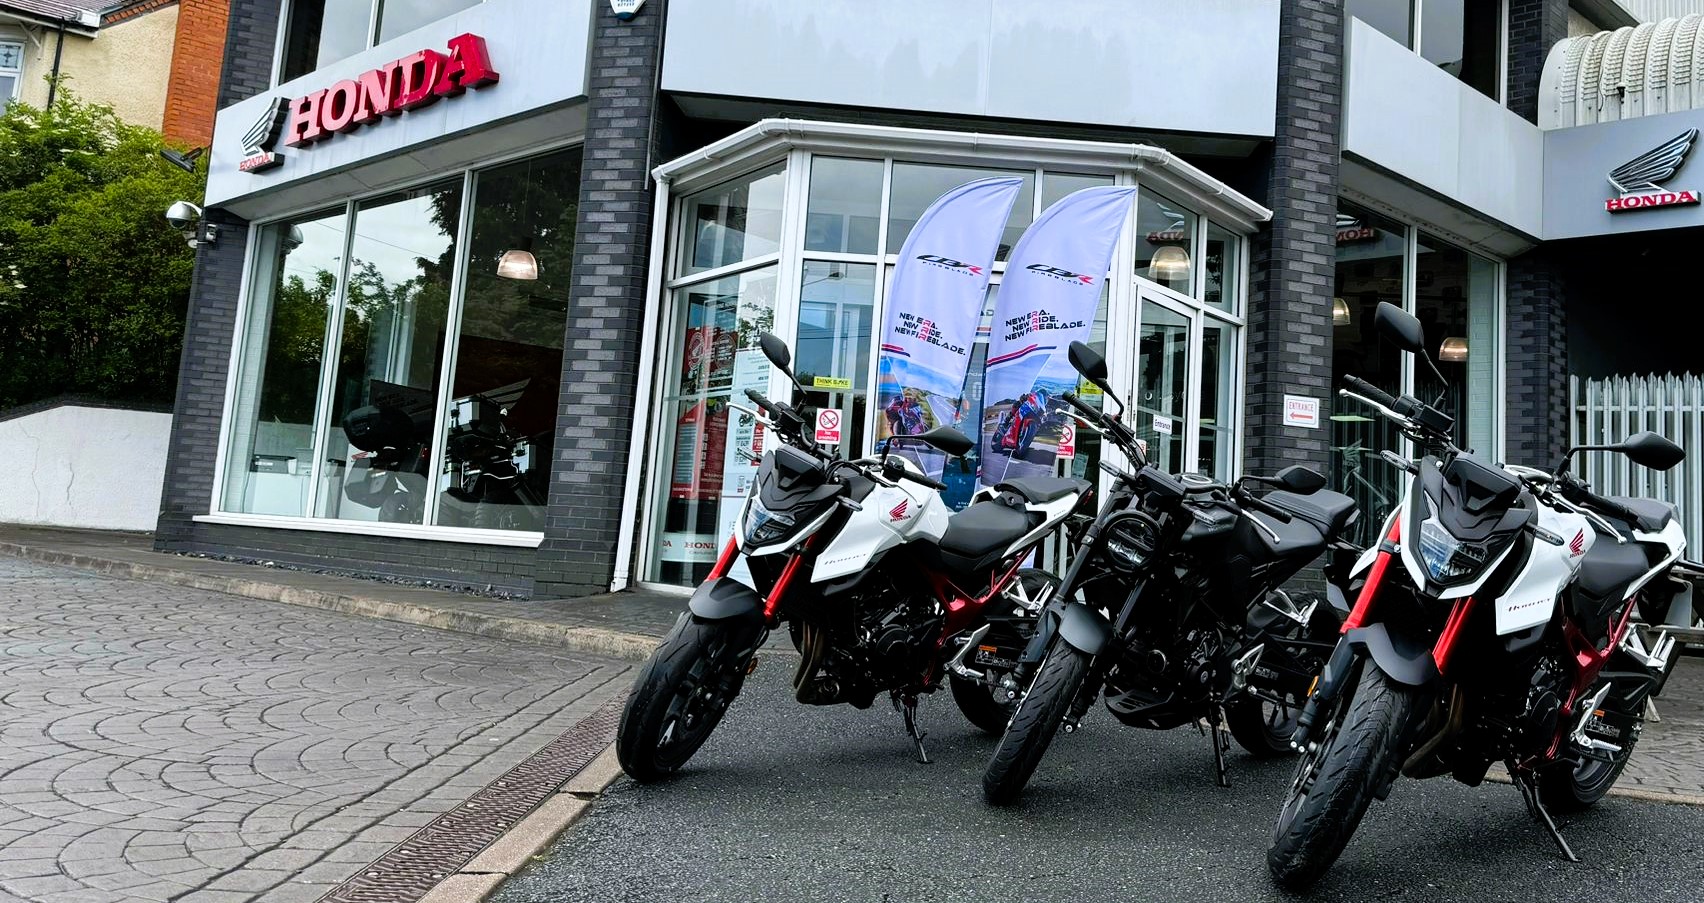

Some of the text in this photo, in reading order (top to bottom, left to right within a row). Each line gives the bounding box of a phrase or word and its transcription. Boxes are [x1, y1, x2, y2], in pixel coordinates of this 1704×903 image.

[284, 32, 500, 147] HONDA
[239, 152, 272, 171] HONDA
[1606, 191, 1696, 211] HONDA
[916, 254, 984, 276] CBR
[1026, 264, 1095, 285] CBR
[916, 317, 938, 330] ERA.
[1005, 309, 1050, 327] NEW ERA.
[1012, 315, 1059, 332] NEW RIDE.
[920, 326, 943, 339] RIDE.
[1005, 320, 1086, 341] NEW FIREBLADE.
[911, 330, 966, 356] FIREBLADE.
[1289, 401, 1314, 412] ENTRANCE
